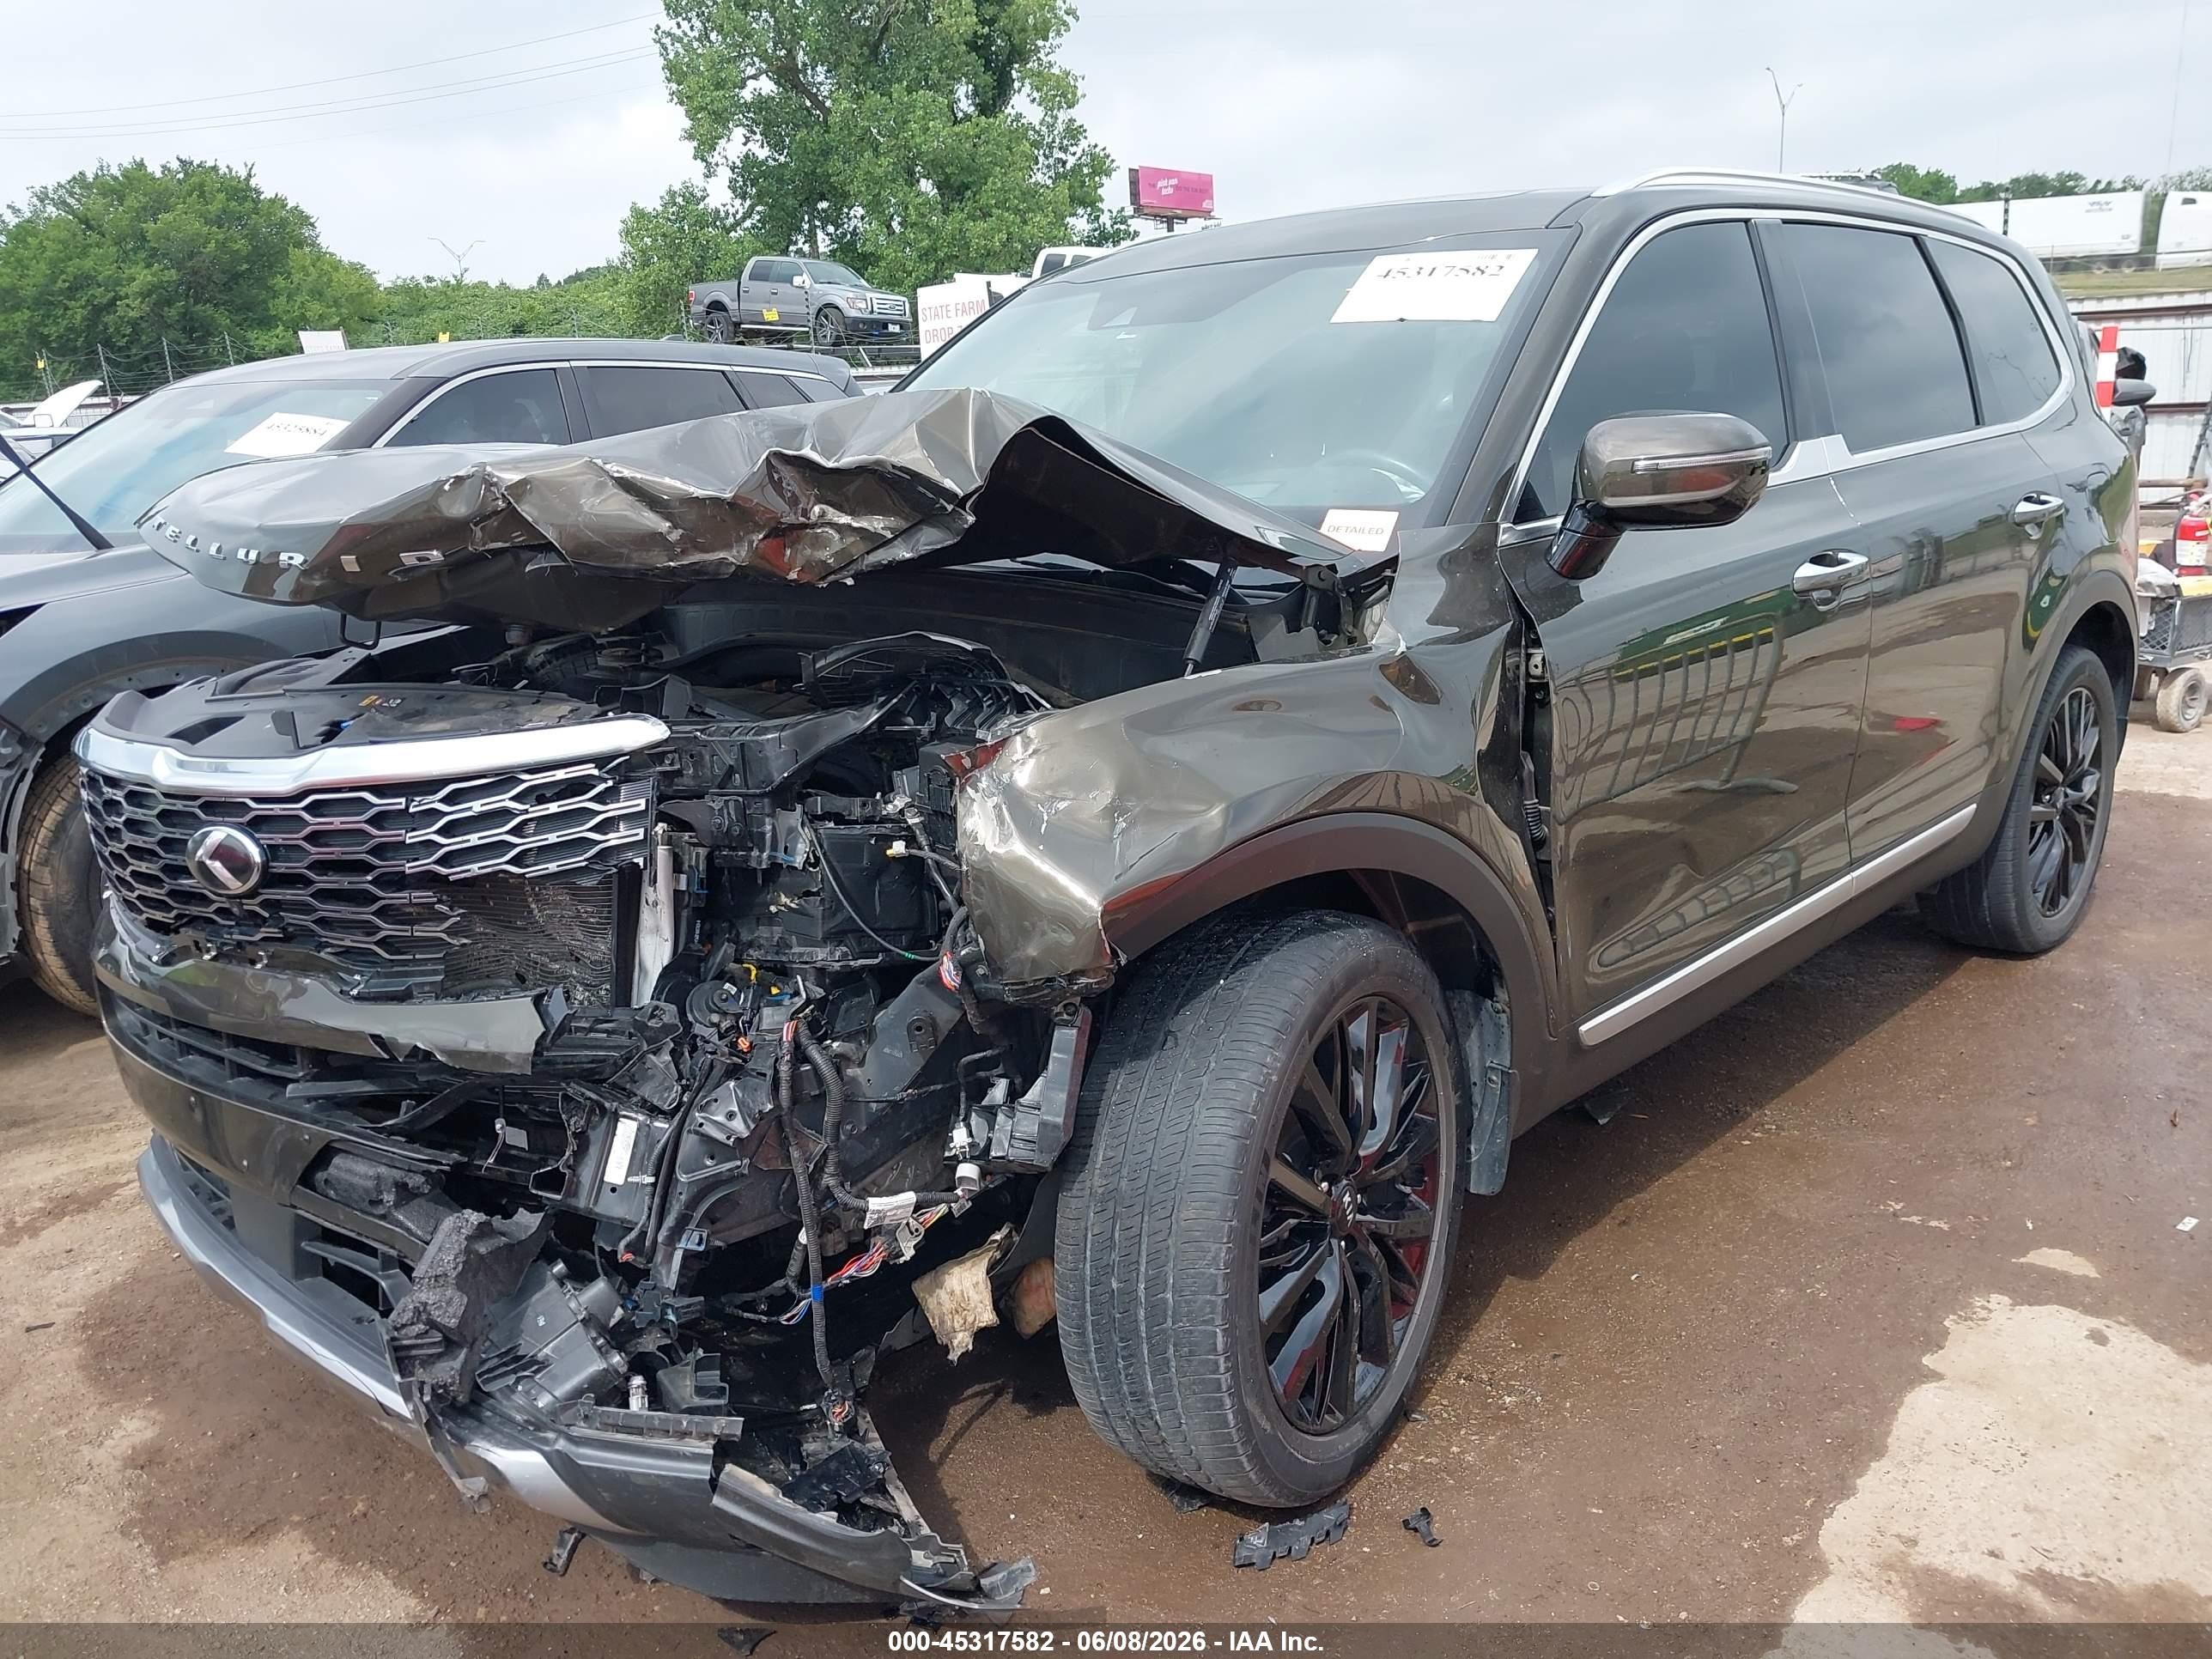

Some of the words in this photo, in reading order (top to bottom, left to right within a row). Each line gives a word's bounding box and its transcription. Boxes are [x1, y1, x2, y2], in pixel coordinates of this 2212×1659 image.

[1377, 264, 1504, 279] 45317582
[921, 304, 951, 322] STATE
[955, 299, 986, 317] FARM
[925, 326, 953, 343] DROP
[1327, 525, 1384, 535] DETAILED
